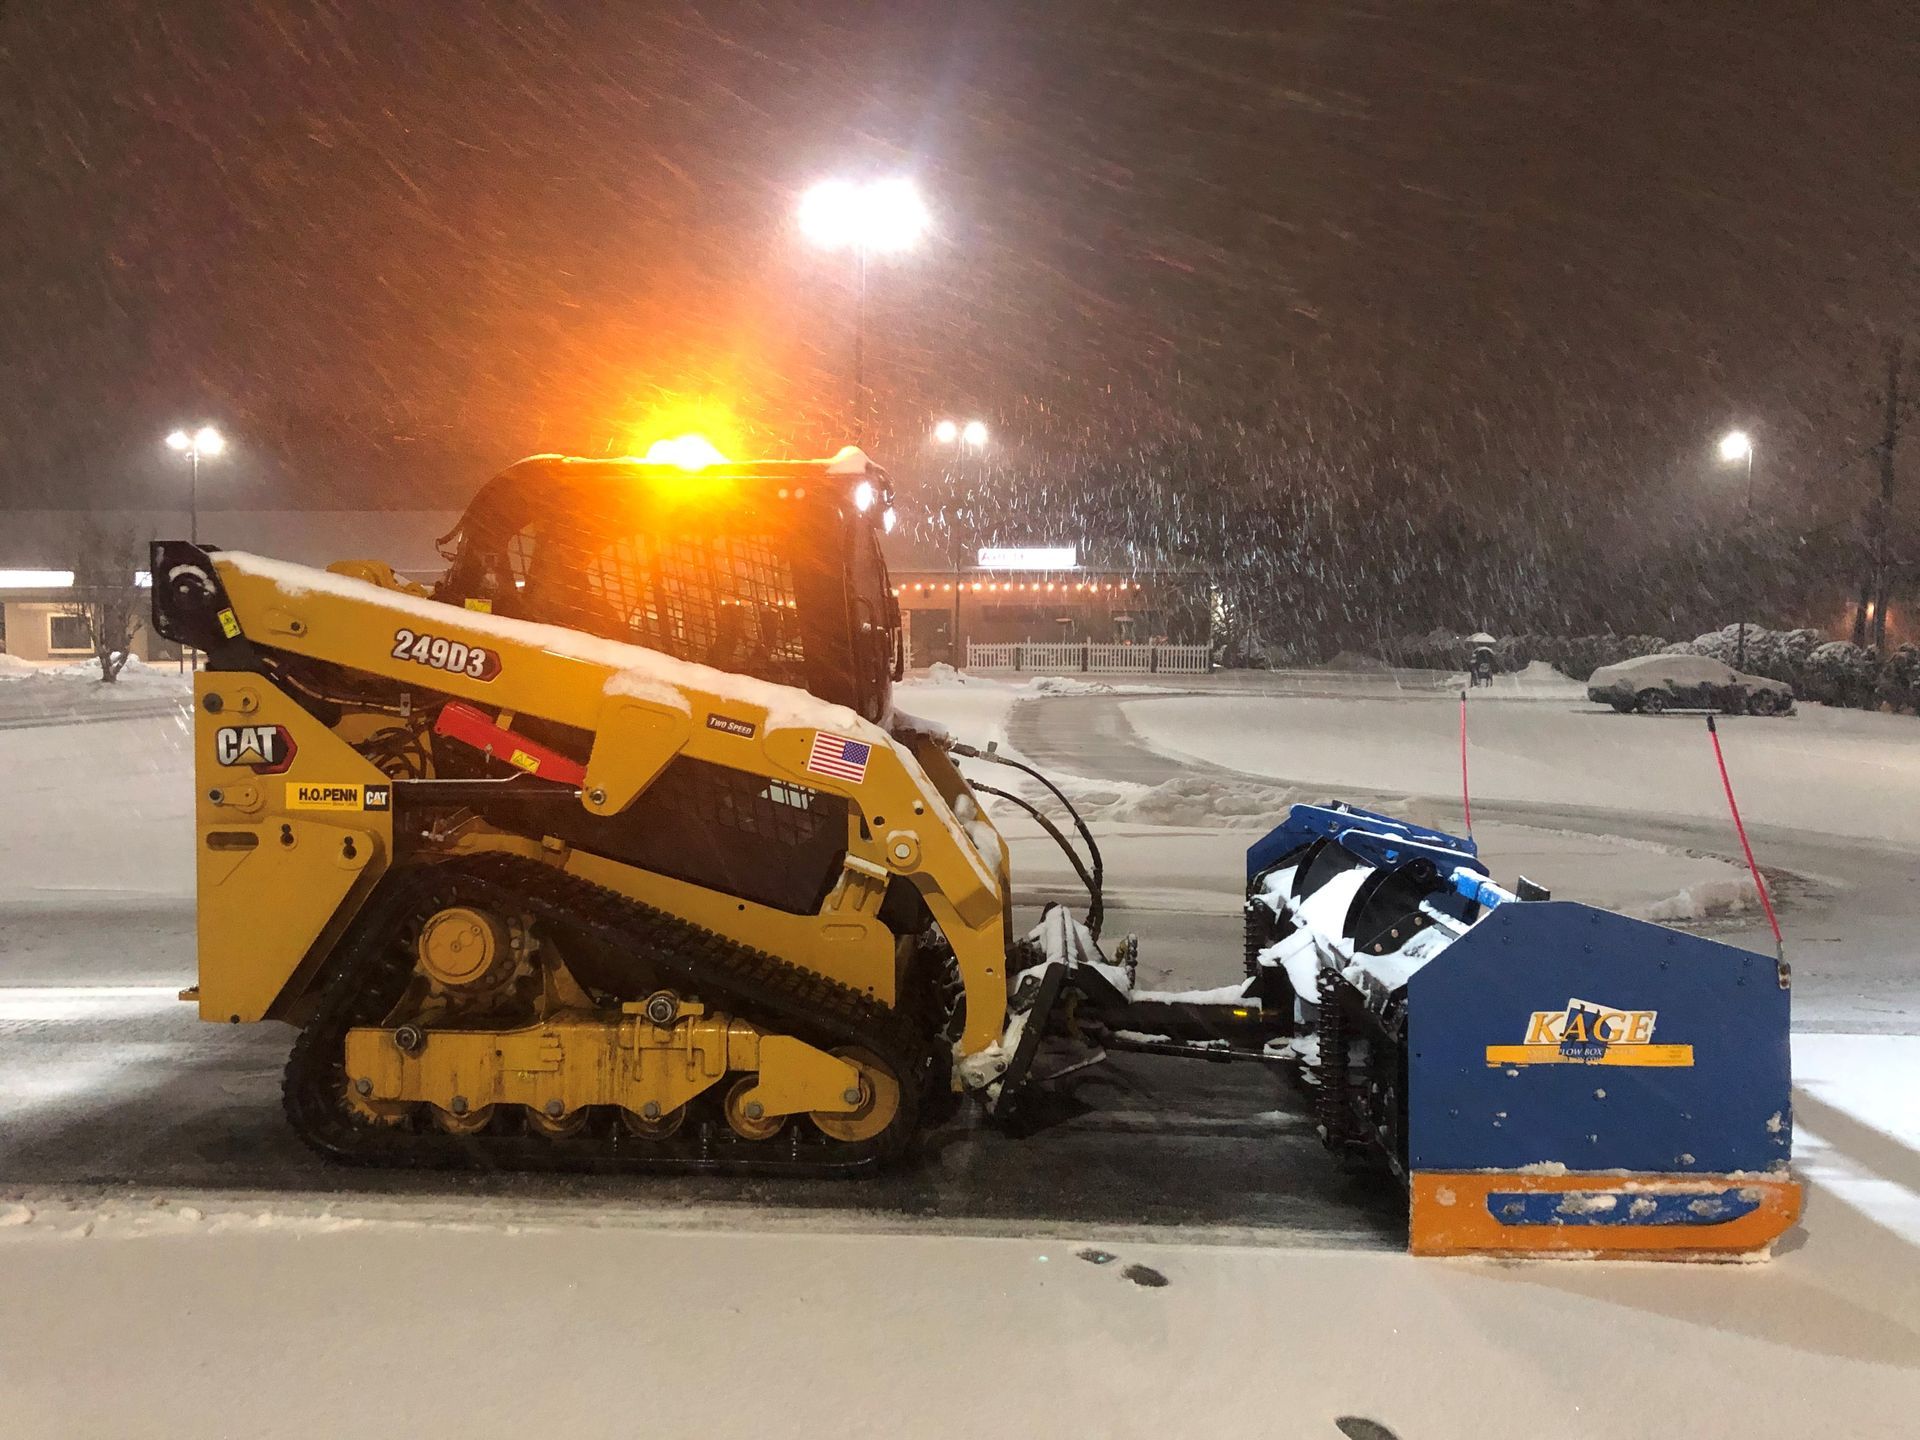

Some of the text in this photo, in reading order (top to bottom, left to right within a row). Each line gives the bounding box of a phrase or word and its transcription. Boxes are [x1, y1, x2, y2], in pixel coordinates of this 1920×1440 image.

[392, 629, 486, 677] 249D3
[217, 726, 277, 765] CAT
[366, 791, 388, 805] CAT
[1527, 1011, 1654, 1043] KAGE
